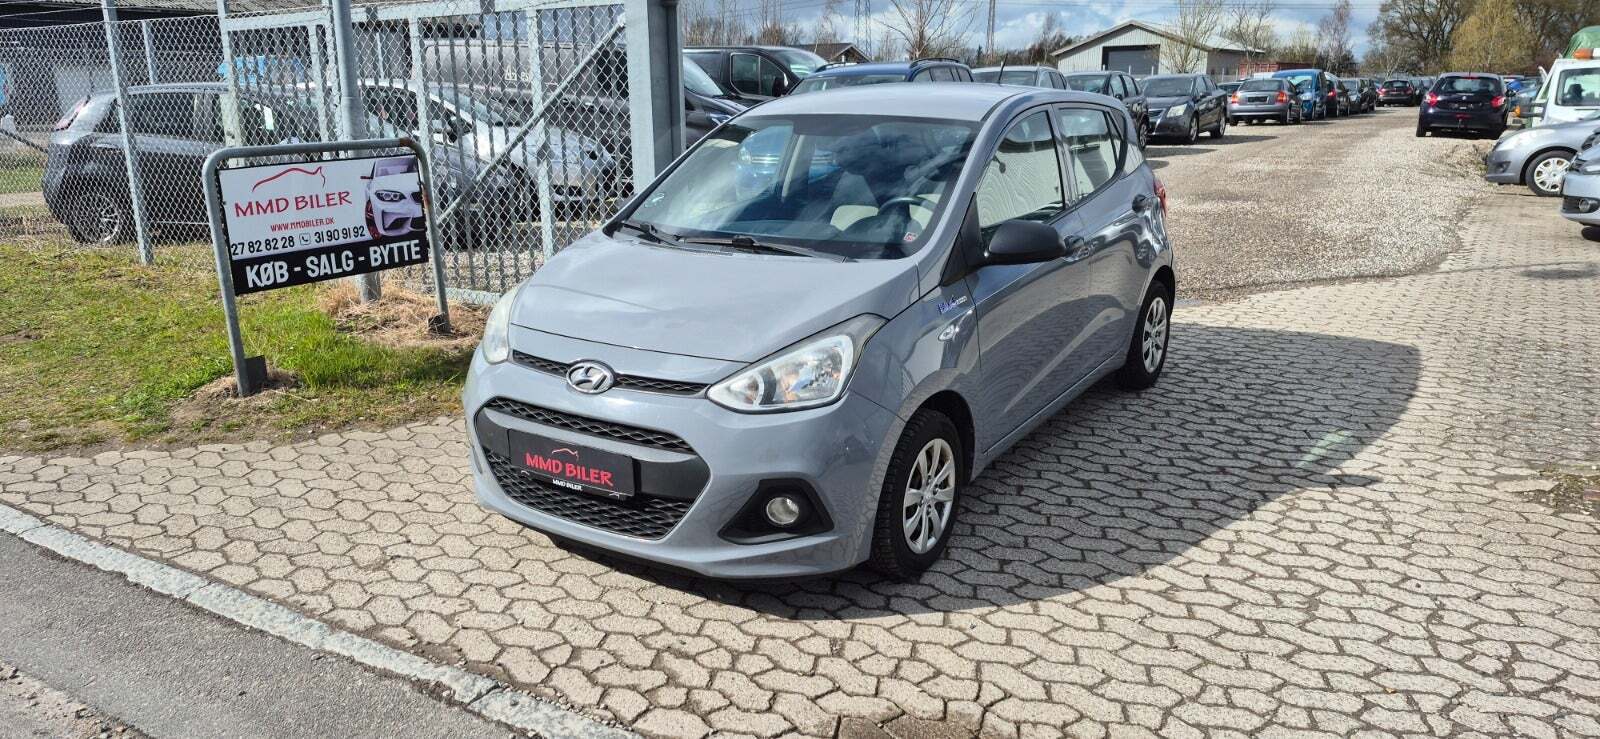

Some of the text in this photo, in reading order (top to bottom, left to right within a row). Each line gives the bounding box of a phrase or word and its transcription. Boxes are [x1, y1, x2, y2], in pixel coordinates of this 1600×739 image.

[235, 191, 352, 217] MMD BILER
[270, 217, 335, 232] WWW.MMDBILER.DK
[231, 226, 365, 256] 27 82 82 28 31 90 91 92
[245, 260, 289, 288] KØB
[306, 250, 355, 278] SALG
[370, 239, 421, 267] BYTTE
[525, 453, 614, 487] MMD BILER
